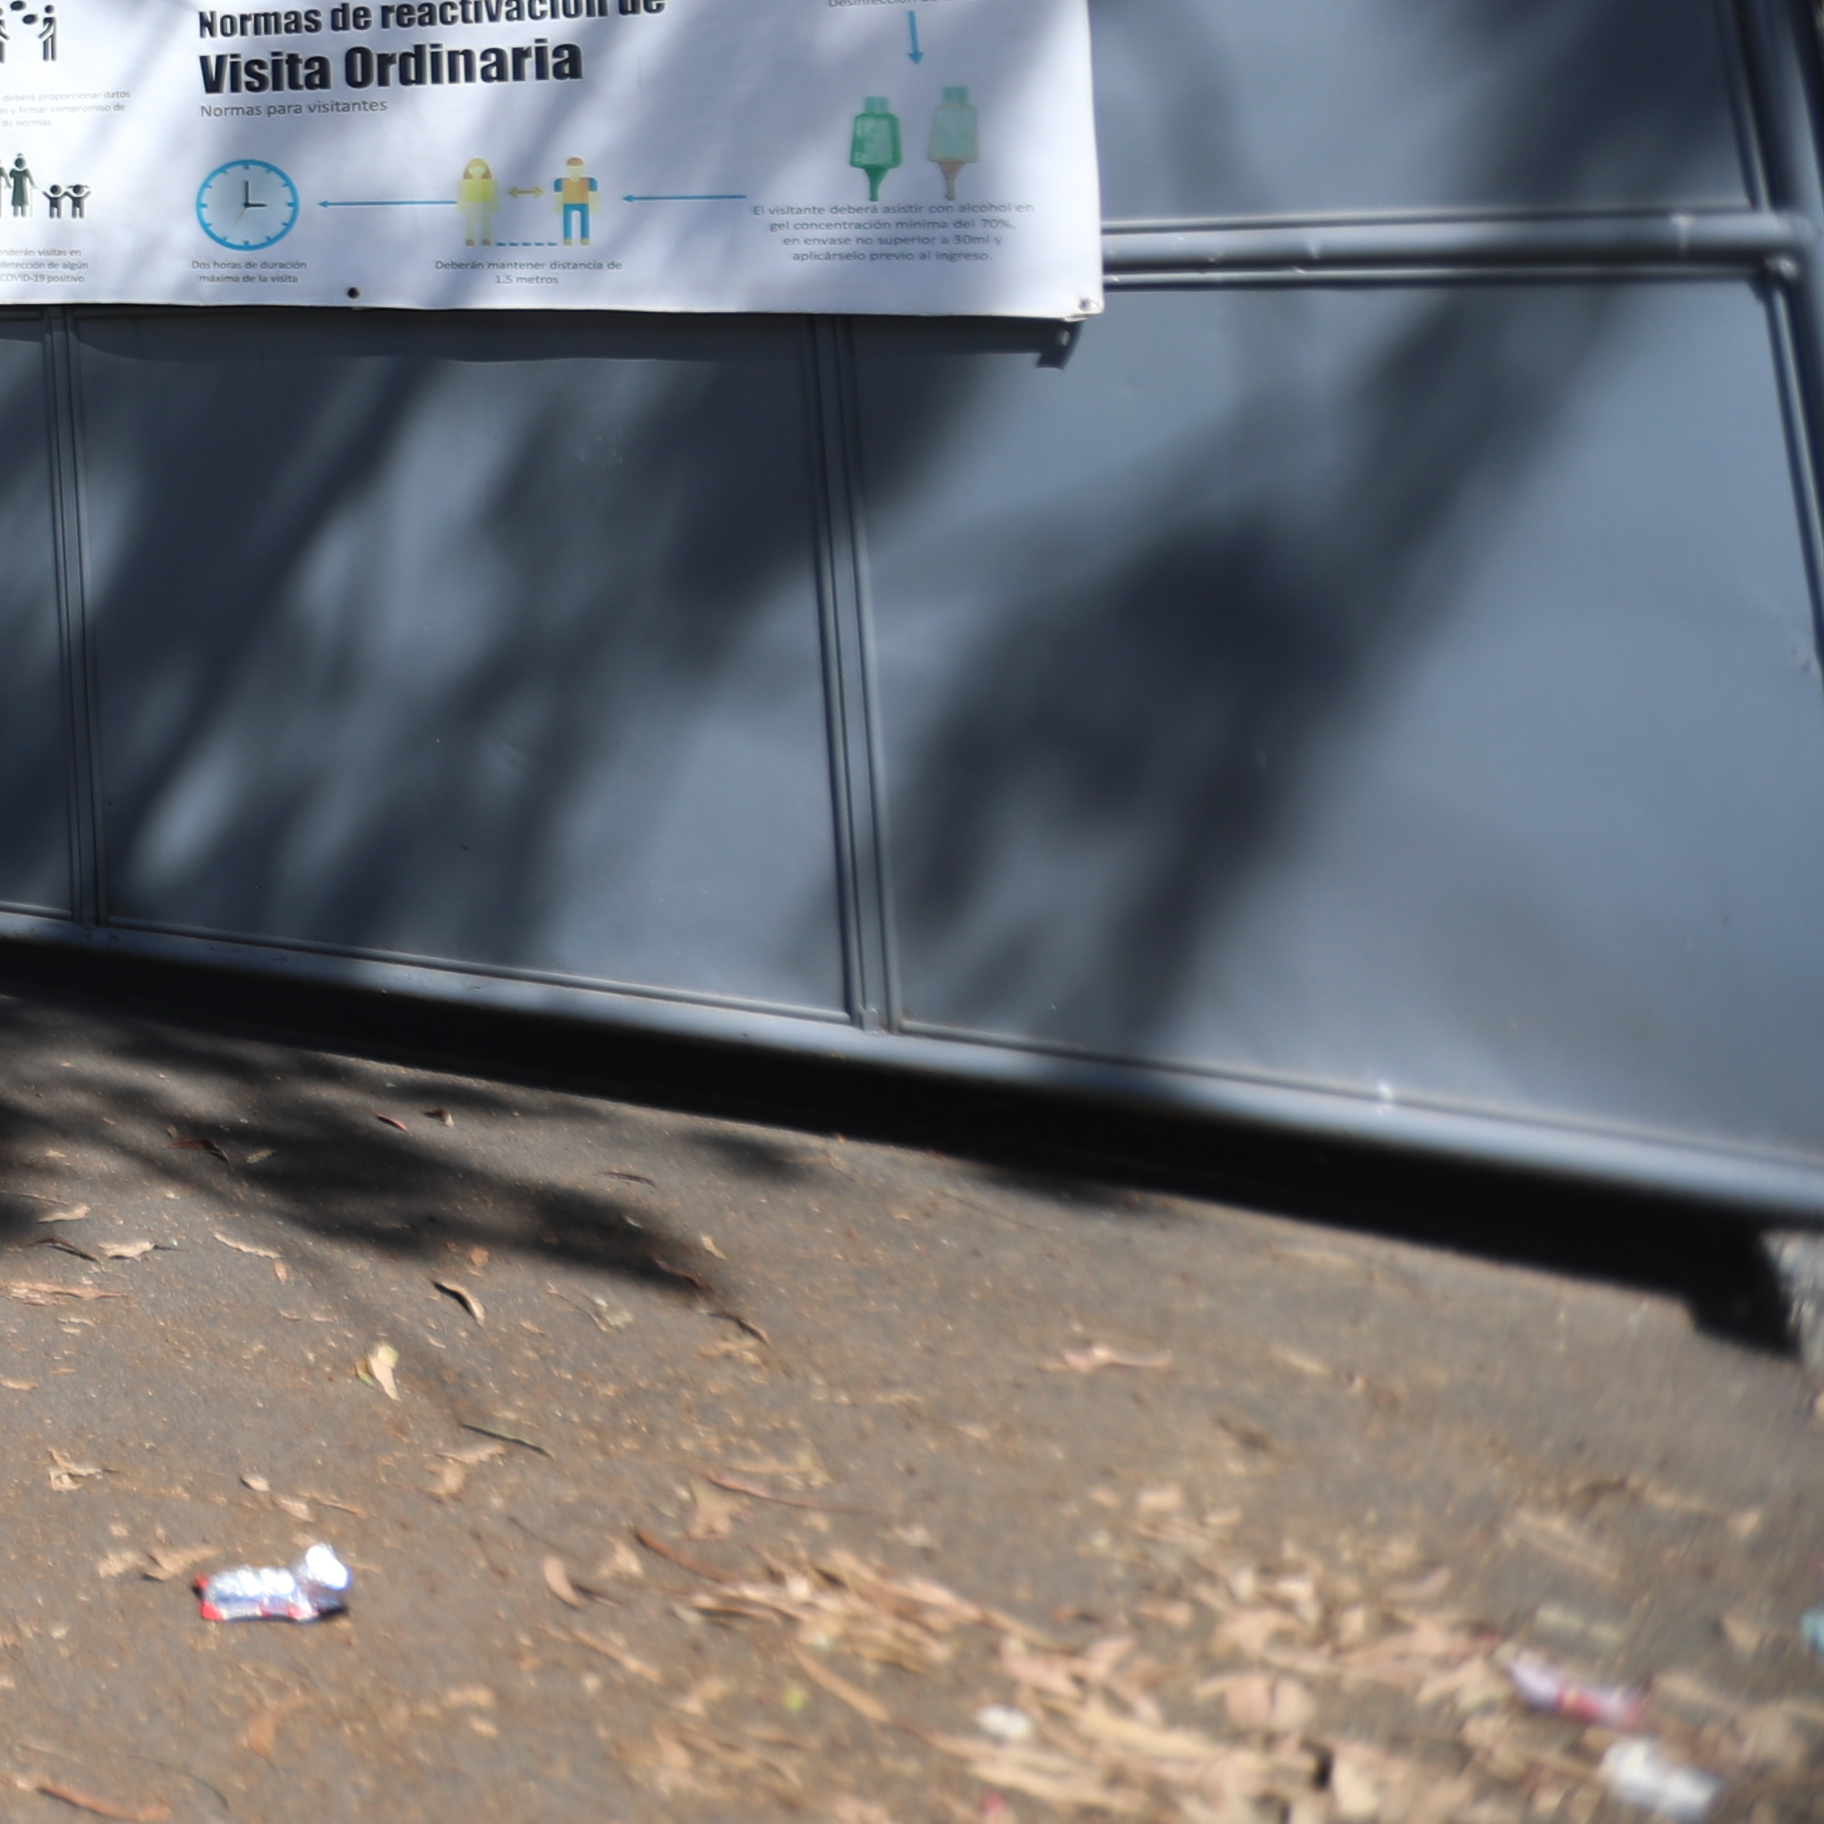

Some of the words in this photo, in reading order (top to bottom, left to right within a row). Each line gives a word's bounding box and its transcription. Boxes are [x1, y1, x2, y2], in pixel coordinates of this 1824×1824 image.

[199, 6, 322, 38] Normas
[331, 2, 372, 32] de
[199, 50, 331, 95] Visita
[344, 37, 583, 89] Ordinaria
[38, 91, 101, 103] proporcionar
[104, 90, 131, 99] datos
[10, 108, 16, 116] y
[18, 106, 47, 114] firmar
[50, 104, 111, 115] compromiso
[113, 103, 126, 112] de
[201, 104, 262, 118] Normas
[267, 103, 304, 118] para
[308, 97, 388, 113] visitantes
[1, 119, 13, 128] de
[16, 119, 51, 127] normas
[753, 205, 764, 215] El
[768, 205, 826, 215] visitante
[883, 204, 924, 214] asistir
[929, 204, 955, 213] con
[958, 202, 1012, 213] alcohol
[1015, 203, 1034, 212] en
[769, 220, 789, 232] gel
[793, 219, 892, 231] concentración
[953, 218, 975, 229] del
[783, 236, 800, 245] en
[803, 236, 851, 245] envase
[856, 236, 873, 245] no
[878, 234, 937, 247] superior
[941, 236, 949, 245] a
[954, 234, 990, 245] 30ml
[993, 236, 1002, 247] y
[37, 248, 67, 256] visitas
[793, 250, 866, 262] aplicárselo
[869, 251, 915, 262] previo
[919, 250, 931, 261] al
[936, 251, 993, 262] ingreso.
[0, 260, 45, 269] detección
[47, 261, 60, 269] de
[192, 260, 210, 269] Dos
[213, 260, 242, 269] horas
[244, 260, 258, 269] de
[260, 260, 307, 269] duración
[435, 260, 484, 270] Deberán
[487, 261, 546, 270] mantener
[549, 260, 603, 270] distancia
[607, 260, 623, 270] de
[1, 273, 46, 282] COVID-19
[47, 273, 85, 283] positivo
[242, 274, 256, 283] de
[259, 274, 269, 283] la
[270, 274, 298, 283] visita
[496, 275, 513, 284] 1.5
[516, 275, 559, 285] metros
